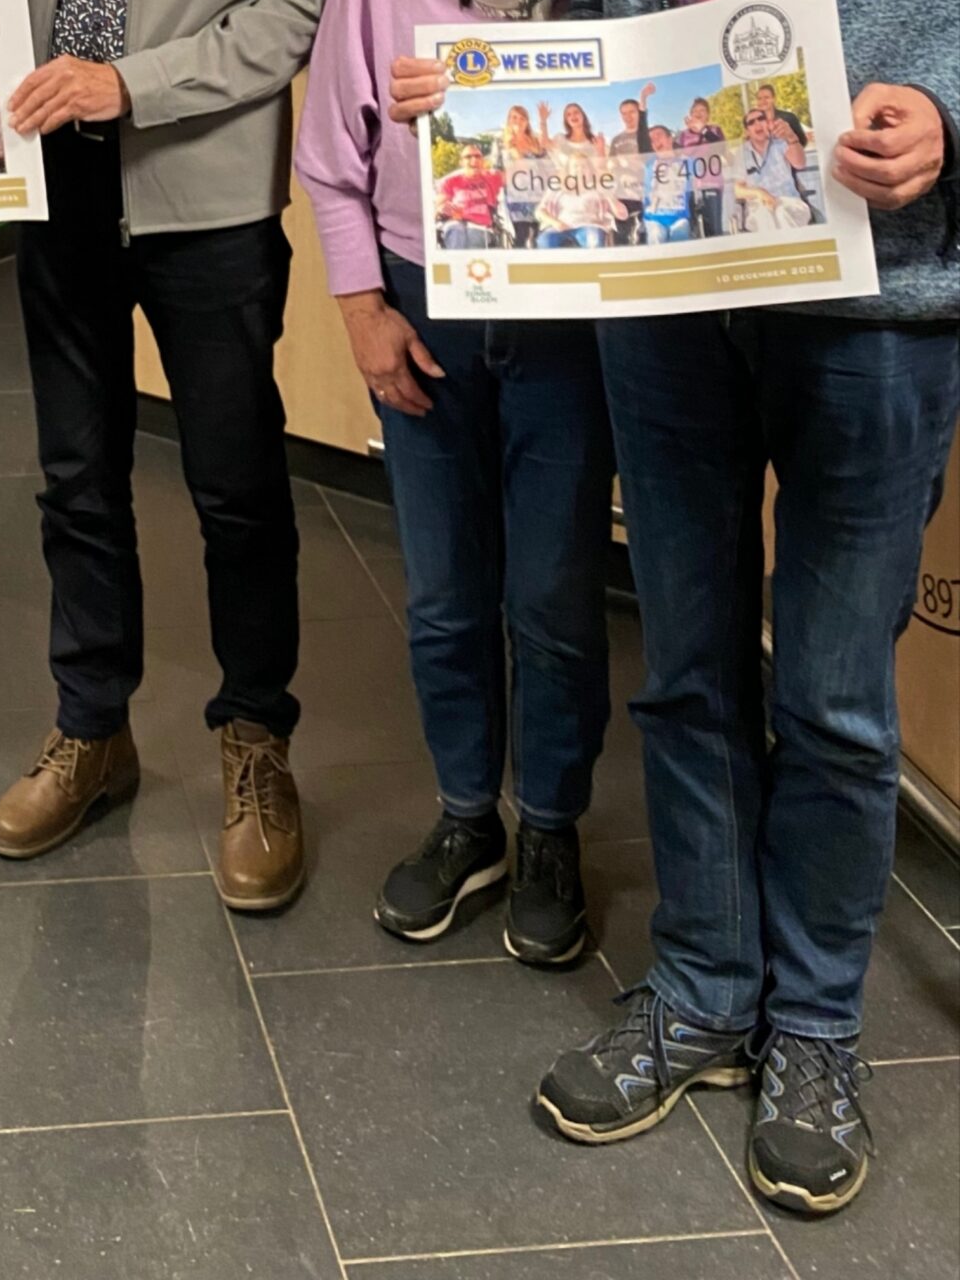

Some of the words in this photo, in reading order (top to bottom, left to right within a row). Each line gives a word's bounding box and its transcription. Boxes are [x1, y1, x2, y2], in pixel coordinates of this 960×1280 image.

[501, 53, 530, 71] WE
[535, 51, 595, 70] SERVE
[511, 169, 615, 196] Cheque
[654, 162, 671, 185] €
[677, 154, 723, 180] 400
